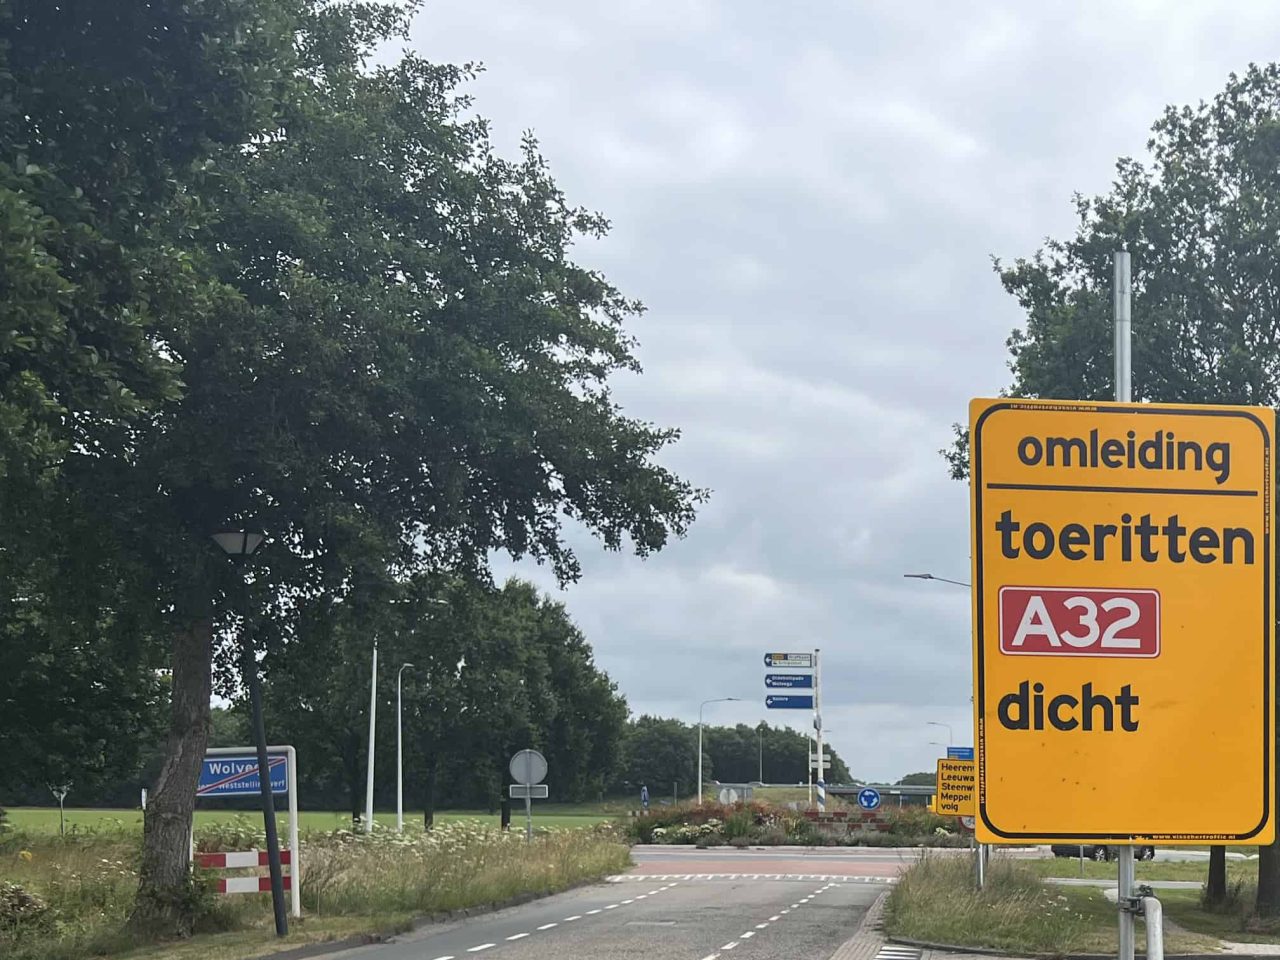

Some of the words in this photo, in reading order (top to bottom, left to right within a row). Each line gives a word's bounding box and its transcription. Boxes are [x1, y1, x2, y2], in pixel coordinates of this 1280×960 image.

[1017, 428, 1231, 484] omleiding
[995, 509, 1255, 565] toeritten
[1011, 595, 1141, 649] A32
[998, 680, 1139, 732] dicht
[209, 763, 271, 777] Wolve
[941, 773, 975, 782] Leeuwa
[941, 793, 972, 802] Meppel
[941, 803, 958, 812] volg
